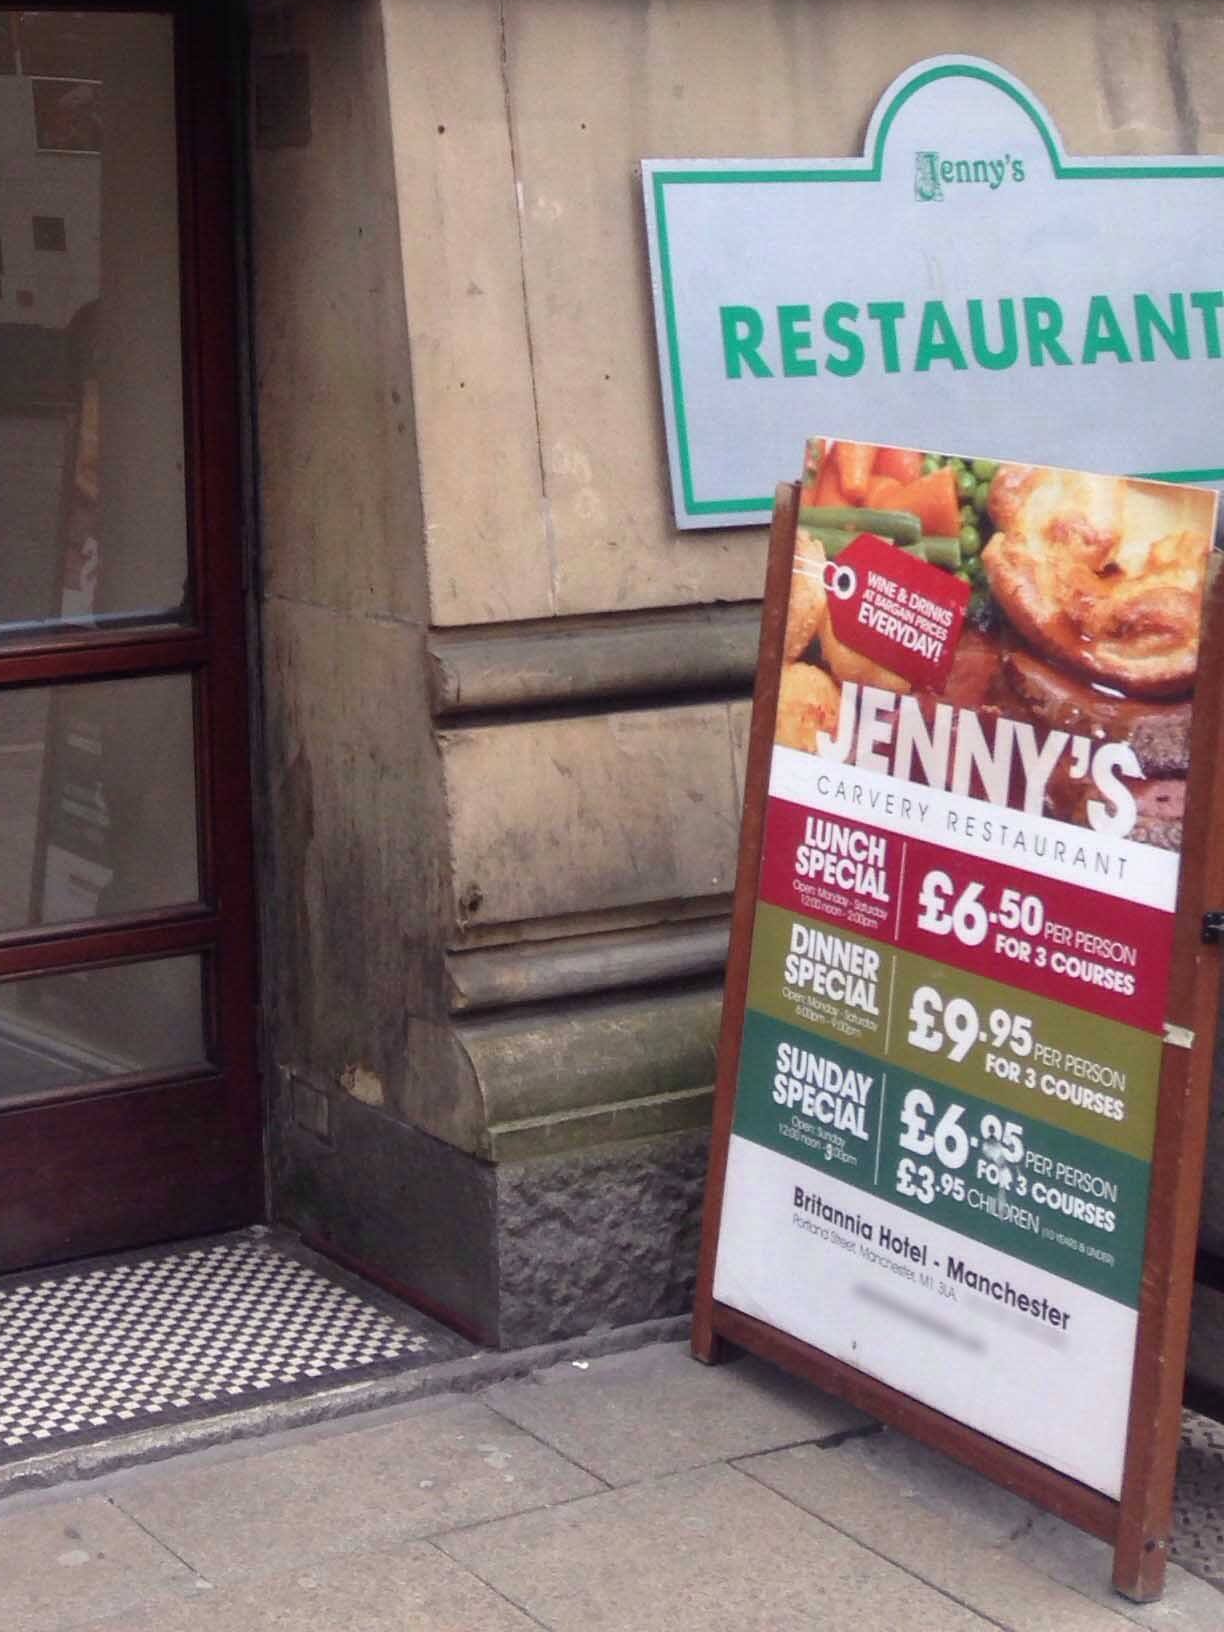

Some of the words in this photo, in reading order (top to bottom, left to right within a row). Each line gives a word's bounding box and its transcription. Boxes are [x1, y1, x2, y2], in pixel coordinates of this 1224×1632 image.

[915, 151, 1025, 201] Jenny's
[720, 291, 1224, 379] RESTAURANT
[862, 589, 875, 602] AT
[874, 594, 915, 624] BARGAIN
[915, 614, 949, 641] PRICES
[868, 571, 898, 598] WINE
[897, 588, 908, 604] &
[908, 592, 953, 627] DRINKS
[858, 601, 943, 662] EVERYDAY!
[816, 681, 1146, 840] JENNY'S
[804, 816, 887, 868] LUNCH
[817, 775, 930, 823] CARVERY
[947, 812, 1129, 880] RESTAURANT
[795, 845, 890, 903] SPECIAL
[917, 870, 1044, 946] £6.50
[1044, 921, 1072, 946] PER
[1075, 930, 1137, 967] PERSON
[784, 954, 880, 1016] SPECIAL
[790, 923, 880, 983] DINNER
[995, 933, 1032, 963] FOR
[1035, 947, 1048, 968] 3
[1050, 952, 1136, 997] COURSES
[907, 986, 1033, 1063] £9.95
[1034, 1043, 1063, 1068] PER
[1064, 1054, 1126, 1093] PERSON
[776, 1042, 874, 1106] SUNDAY
[985, 1053, 1021, 1083] FOR
[1025, 1068, 1037, 1089] 3
[1040, 1074, 1125, 1121] COURSES
[772, 1073, 869, 1141] SPECIAL
[895, 1157, 966, 1204] £3.95
[967, 1189, 1040, 1235] CHILDREN
[976, 1159, 1012, 1191] FOR
[1015, 1175, 1027, 1197] 3
[1031, 1182, 1116, 1233] COURSES
[1025, 1150, 1053, 1178] PER
[1055, 1162, 1118, 1203] PERSON
[793, 1186, 873, 1241] Britannia
[879, 1225, 928, 1266] Hotel
[947, 1256, 1071, 1331] Manchester
